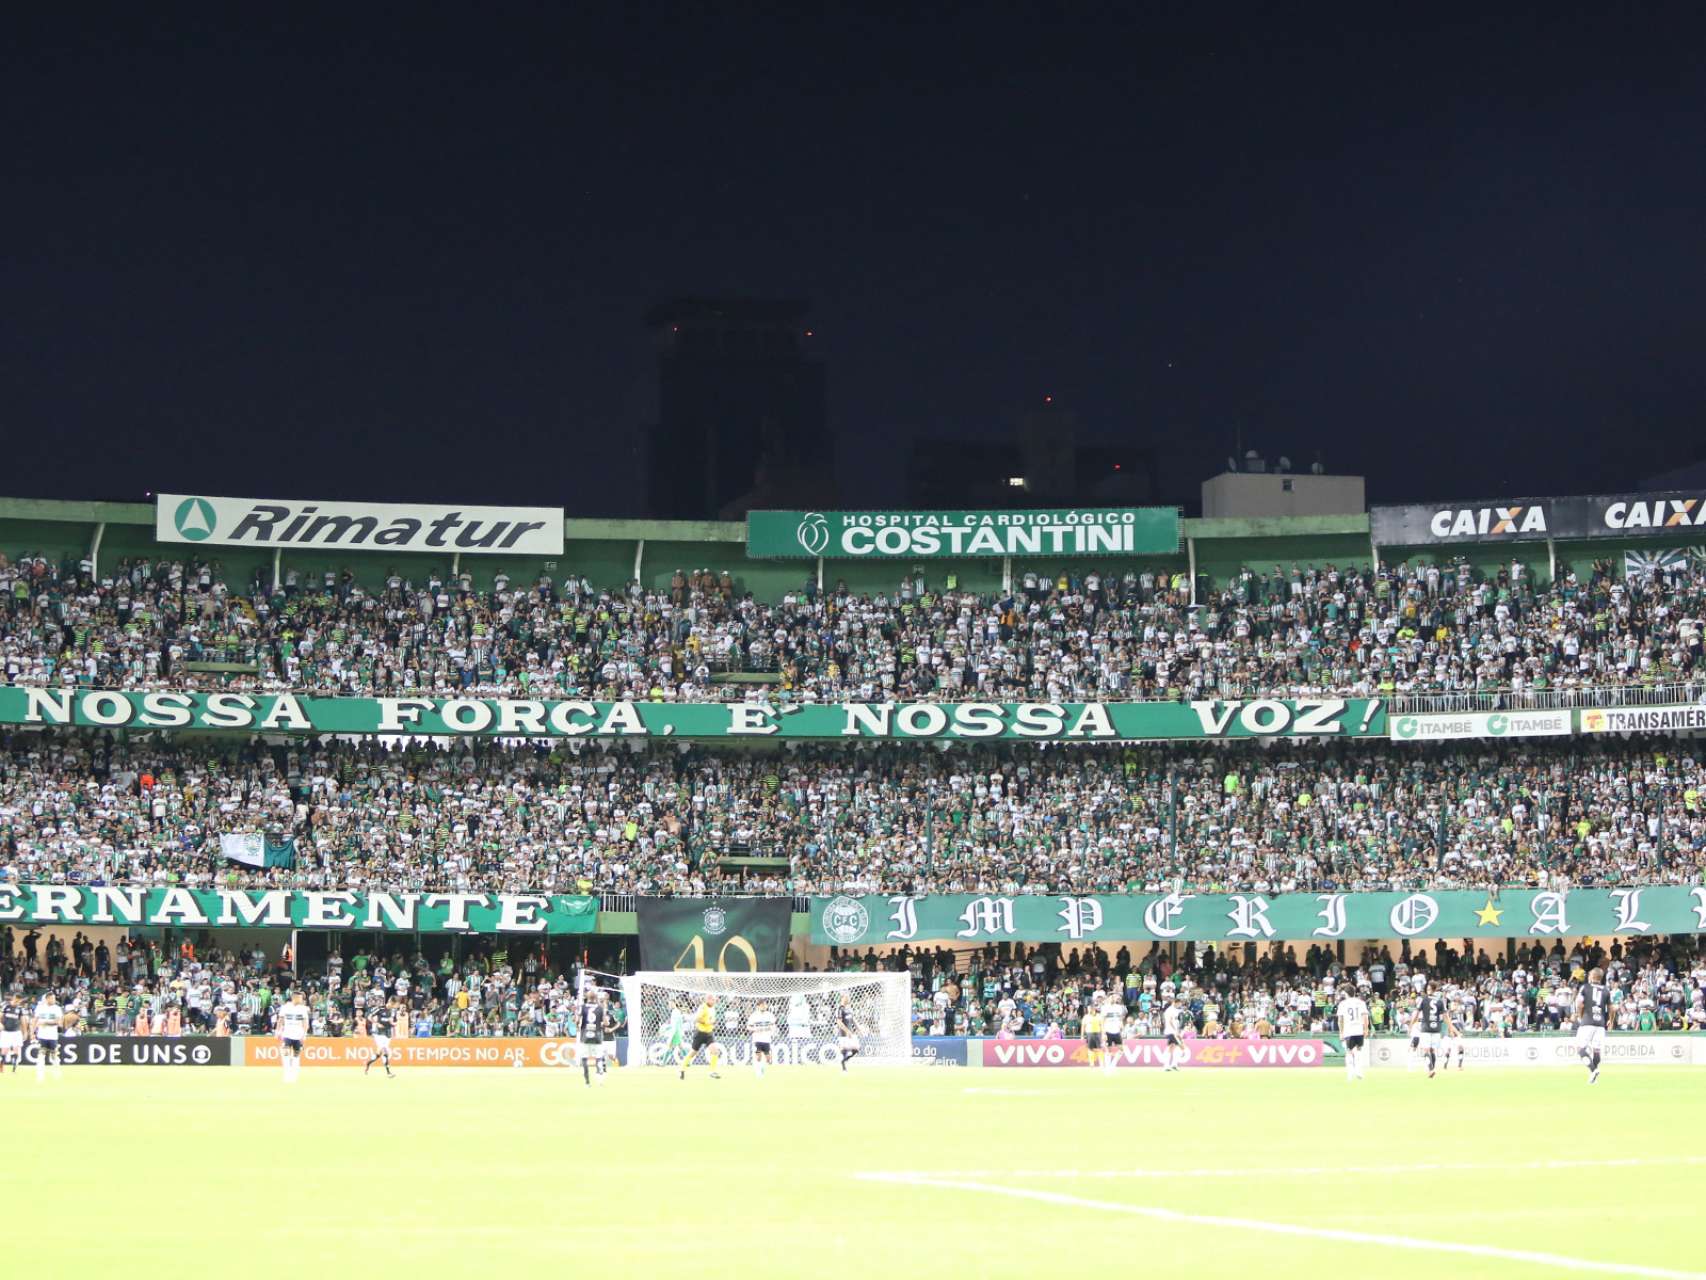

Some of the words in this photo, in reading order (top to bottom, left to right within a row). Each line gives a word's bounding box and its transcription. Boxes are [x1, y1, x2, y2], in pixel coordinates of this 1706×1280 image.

[229, 504, 546, 549] Rimatur
[843, 515, 952, 526] HOSPITAL
[964, 511, 1136, 525] CARDIOLÓGICO
[1430, 506, 1547, 537] CAIXA
[841, 525, 1135, 554] COSTANTINI
[24, 688, 312, 729] NOSSA
[842, 704, 1117, 737] NOSSA
[1420, 720, 1473, 735] ITAMBÉ
[1511, 716, 1563, 731] ITAMBÉ
[88, 1044, 122, 1063] DE
[133, 1044, 187, 1063] UNS
[406, 1047, 471, 1060] TEMPOS
[475, 1048, 499, 1060] NO
[994, 1045, 1065, 1063] VIVO
[1248, 1045, 1316, 1064] VIVO
